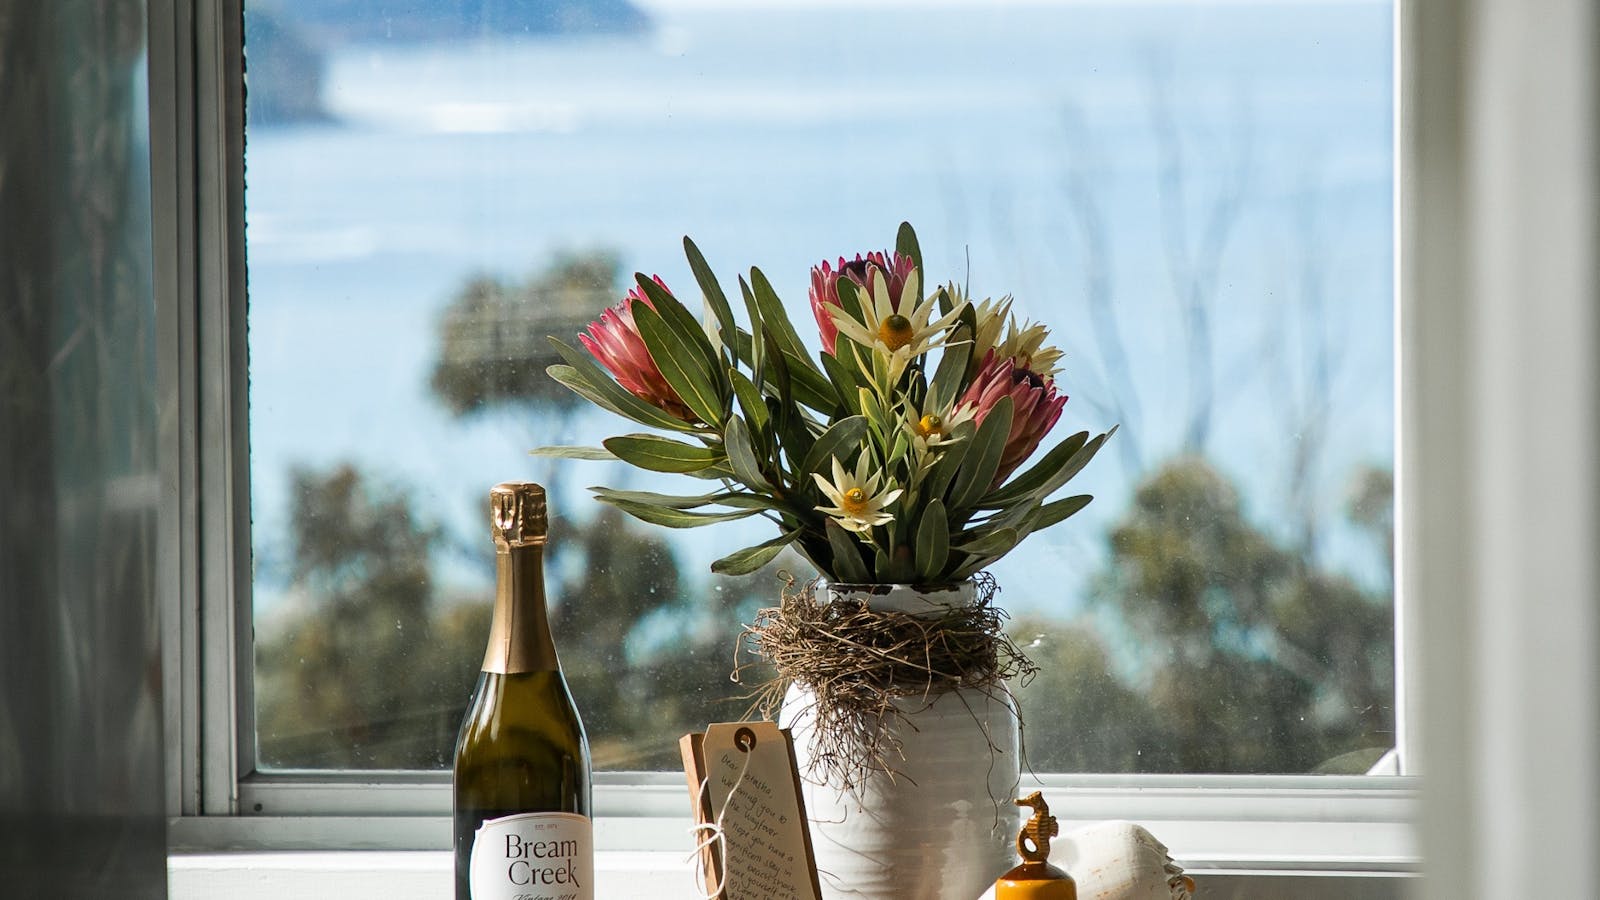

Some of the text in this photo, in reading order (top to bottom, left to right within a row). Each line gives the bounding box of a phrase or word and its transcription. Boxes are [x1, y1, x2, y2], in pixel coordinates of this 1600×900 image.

[721, 754, 774, 800] Dear atasha,
[721, 775, 759, 811] Weloming
[755, 804, 776, 819] you
[505, 833, 578, 859] Bream
[508, 859, 581, 888] Creek
